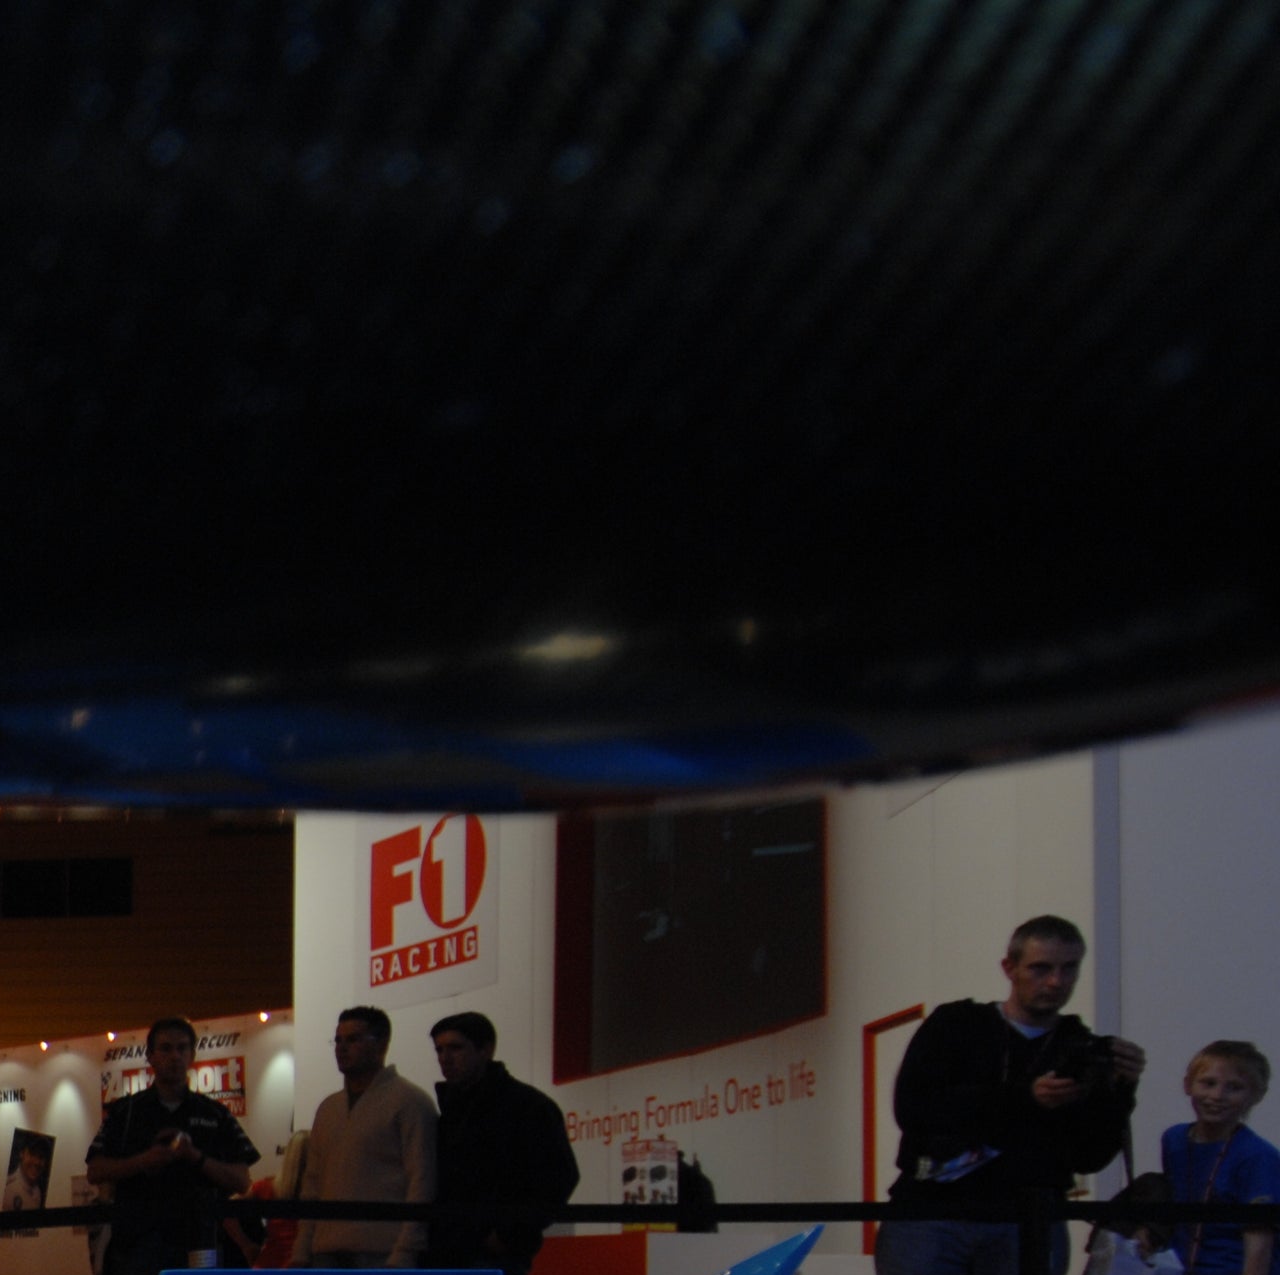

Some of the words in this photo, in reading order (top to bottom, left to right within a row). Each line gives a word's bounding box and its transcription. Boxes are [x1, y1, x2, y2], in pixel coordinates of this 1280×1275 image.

[371, 811, 486, 951] F1
[371, 929, 478, 985] RACING
[566, 1106, 640, 1145] Bringing
[645, 1085, 720, 1128] Formula
[724, 1077, 762, 1114] One
[766, 1073, 785, 1107] to
[789, 1059, 816, 1100] life
